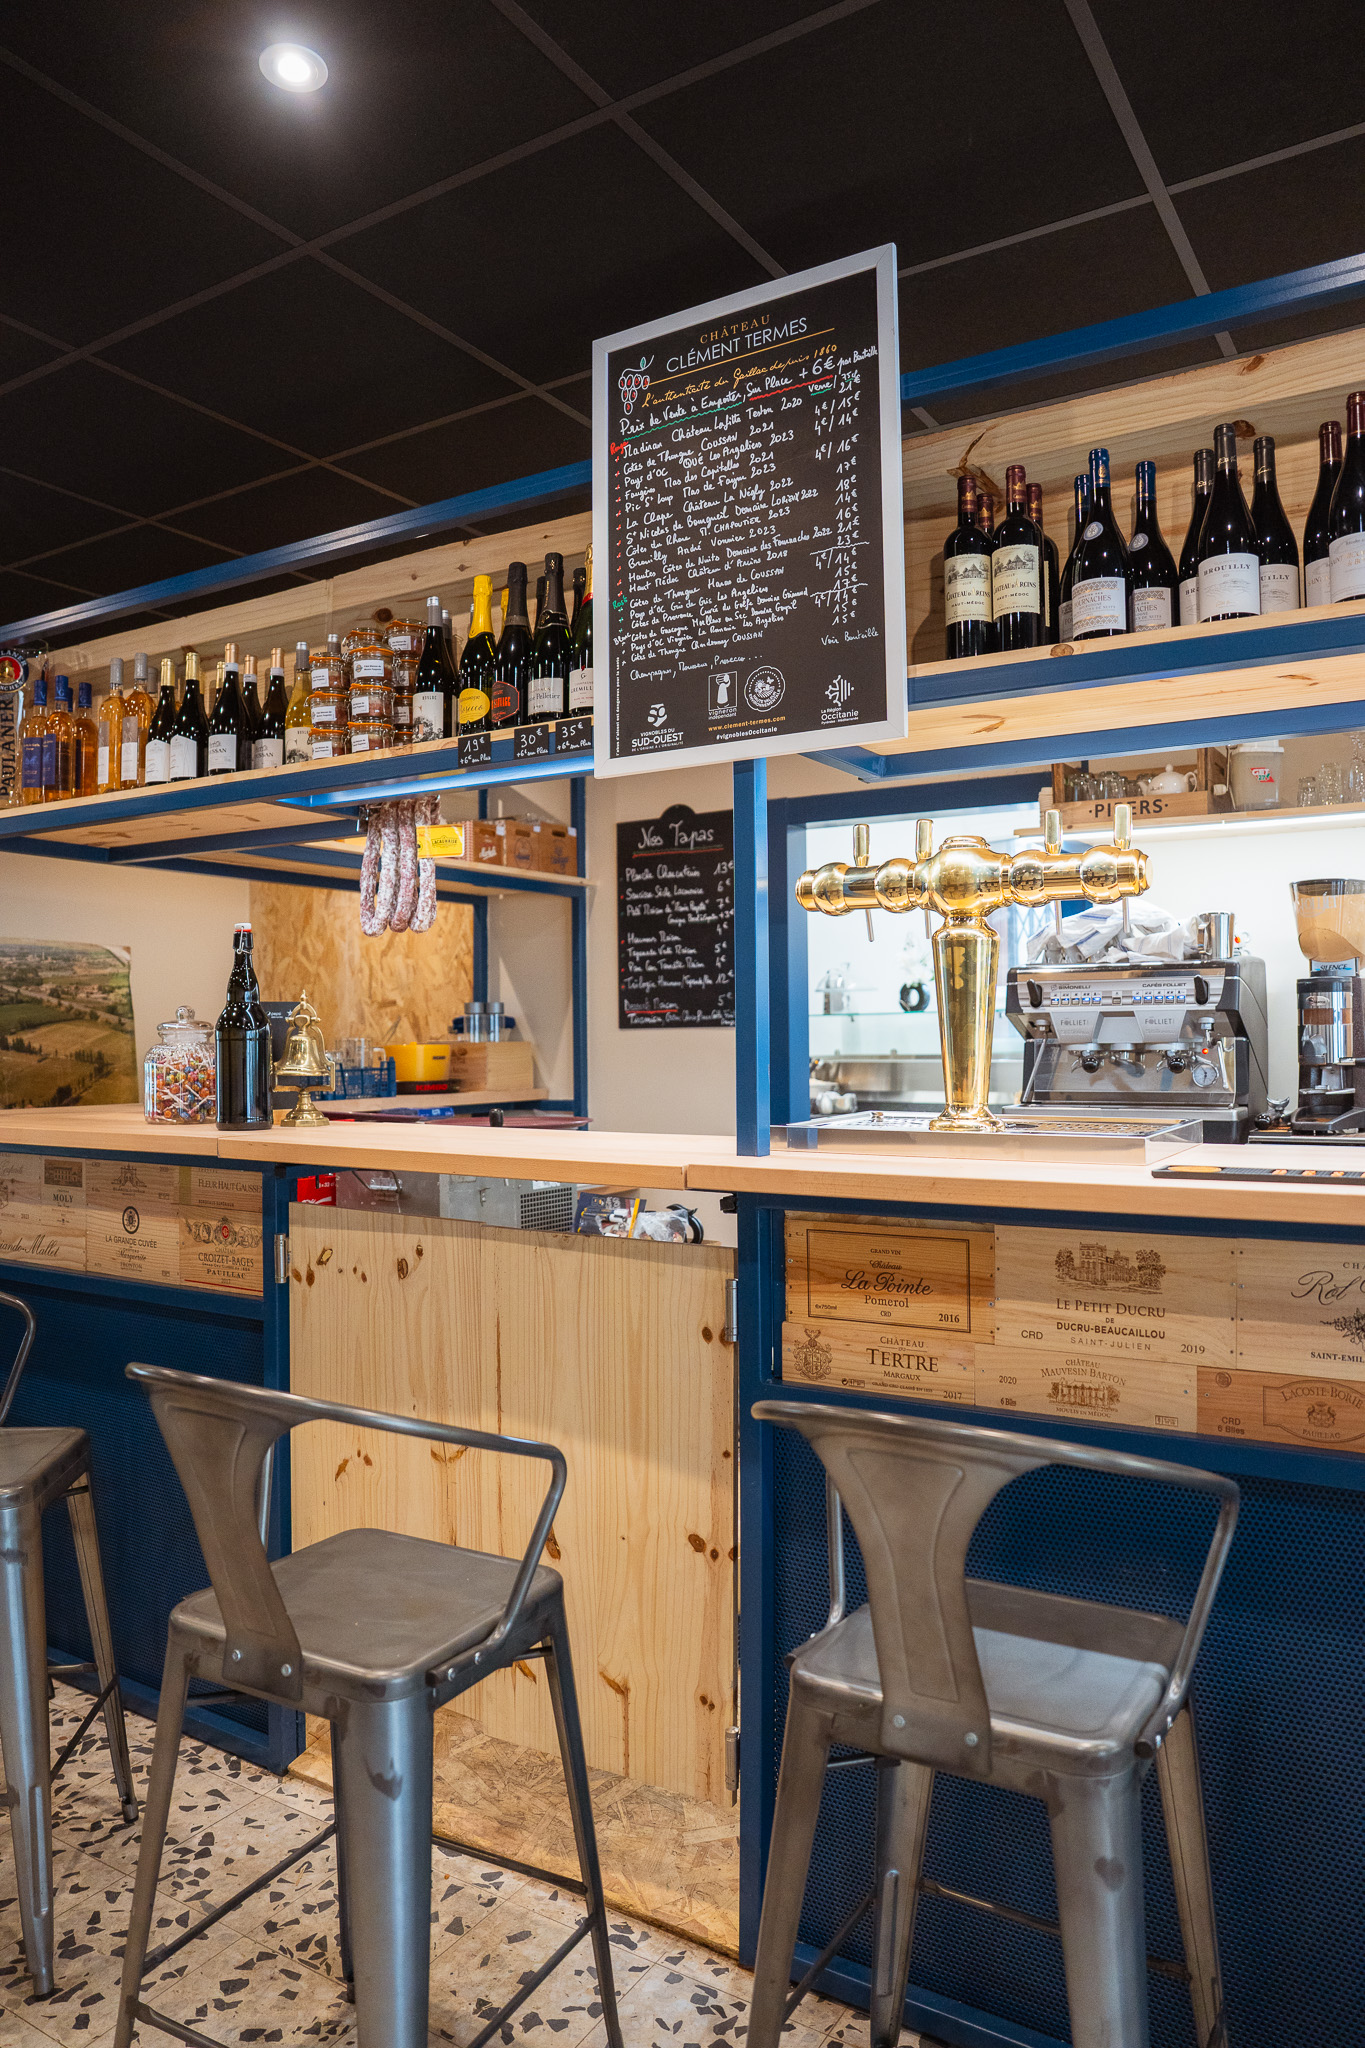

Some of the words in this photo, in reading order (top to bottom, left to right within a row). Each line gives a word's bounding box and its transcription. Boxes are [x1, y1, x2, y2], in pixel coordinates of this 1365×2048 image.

[700, 315, 770, 344] CHÂTEAU
[666, 338, 741, 372] CLÉMENT
[745, 317, 807, 348] TERMES
[814, 345, 837, 359] 1860
[620, 418, 645, 436] Prix
[650, 413, 661, 427] de
[663, 404, 687, 420] Vente
[691, 397, 698, 412] à
[746, 382, 762, 397] Sur
[765, 375, 792, 391] Place
[623, 442, 663, 459] Madiran
[671, 425, 712, 442] Château
[781, 397, 803, 411] 2020
[646, 458, 657, 468] de
[749, 421, 774, 436] 2021
[624, 476, 644, 490] Pays
[769, 430, 795, 447] 2023
[684, 471, 698, 483] des
[749, 451, 774, 466] 2021
[625, 503, 641, 513] Pic
[703, 481, 716, 491] de
[751, 463, 776, 478] 2023
[626, 518, 639, 530] La
[643, 512, 674, 526] Clape
[683, 500, 721, 513] Château
[723, 492, 735, 503] La
[769, 477, 794, 491] 2022
[640, 526, 670, 541] Nicolas
[673, 520, 684, 531] de
[735, 502, 769, 516] Domaine
[800, 488, 819, 500] 2022
[650, 540, 663, 549] du
[768, 506, 791, 520] 2023
[628, 550, 668, 569] Brouilly
[677, 540, 702, 556] André
[749, 525, 776, 538] 2023
[685, 559, 696, 569] de
[726, 545, 759, 558] Domaine
[760, 540, 772, 551] des
[812, 525, 833, 539] 2022
[629, 582, 652, 593] Haut
[687, 567, 722, 579] Château
[766, 550, 789, 561] 2018
[1203, 563, 1251, 576] BROUILLY
[653, 594, 663, 604] de
[736, 573, 749, 583] de
[821, 709, 859, 721] Occitanie
[1, 692, 16, 797] PAULANER
[631, 732, 684, 748] SUD-OUEST
[1094, 799, 1164, 818] PIERS
[638, 825, 664, 849] Nos
[668, 820, 714, 850] Tapas
[1060, 1017, 1087, 1027] FOLLIET
[1145, 1016, 1172, 1026] FOLLIET
[53, 1194, 74, 1203] MOLY
[105, 1235, 112, 1243] LA
[113, 1236, 137, 1246] GRANDE
[138, 1238, 158, 1249] CUVÉE
[198, 1252, 254, 1268] CROIZET-BAGES
[869, 1259, 903, 1271] Château
[206, 1268, 246, 1279] PAUILLAC
[841, 1269, 871, 1291] La
[873, 1271, 934, 1296] Pointe
[864, 1294, 910, 1309] Pomerol
[1056, 1298, 1070, 1311] LE
[1075, 1300, 1111, 1314] PETIT
[1115, 1303, 1167, 1319] DUCRU
[880, 1310, 892, 1318] CRD
[938, 1313, 960, 1324] 2016
[1021, 1330, 1044, 1340] CRD
[1056, 1321, 1166, 1340] DUCRU-BEAUCAILLOU
[879, 1336, 925, 1349] CHÂTEAU
[1070, 1336, 1152, 1351] SAINT-JULIEN
[1180, 1343, 1206, 1355] 2019
[866, 1347, 939, 1373] TERTRE
[1065, 1358, 1101, 1369] CHÂTEAU
[883, 1370, 922, 1382] MARGAUX
[998, 1375, 1017, 1385] 2020
[1041, 1367, 1088, 1378] MAUVESIN
[1089, 1368, 1127, 1387] BARTON
[943, 1390, 963, 1401] 2017
[1281, 1386, 1364, 1410] LACOSTE-BORIE
[1217, 1424, 1223, 1432] 6
[1221, 1416, 1241, 1426] CRD
[1302, 1429, 1341, 1439] PAUILLAC
